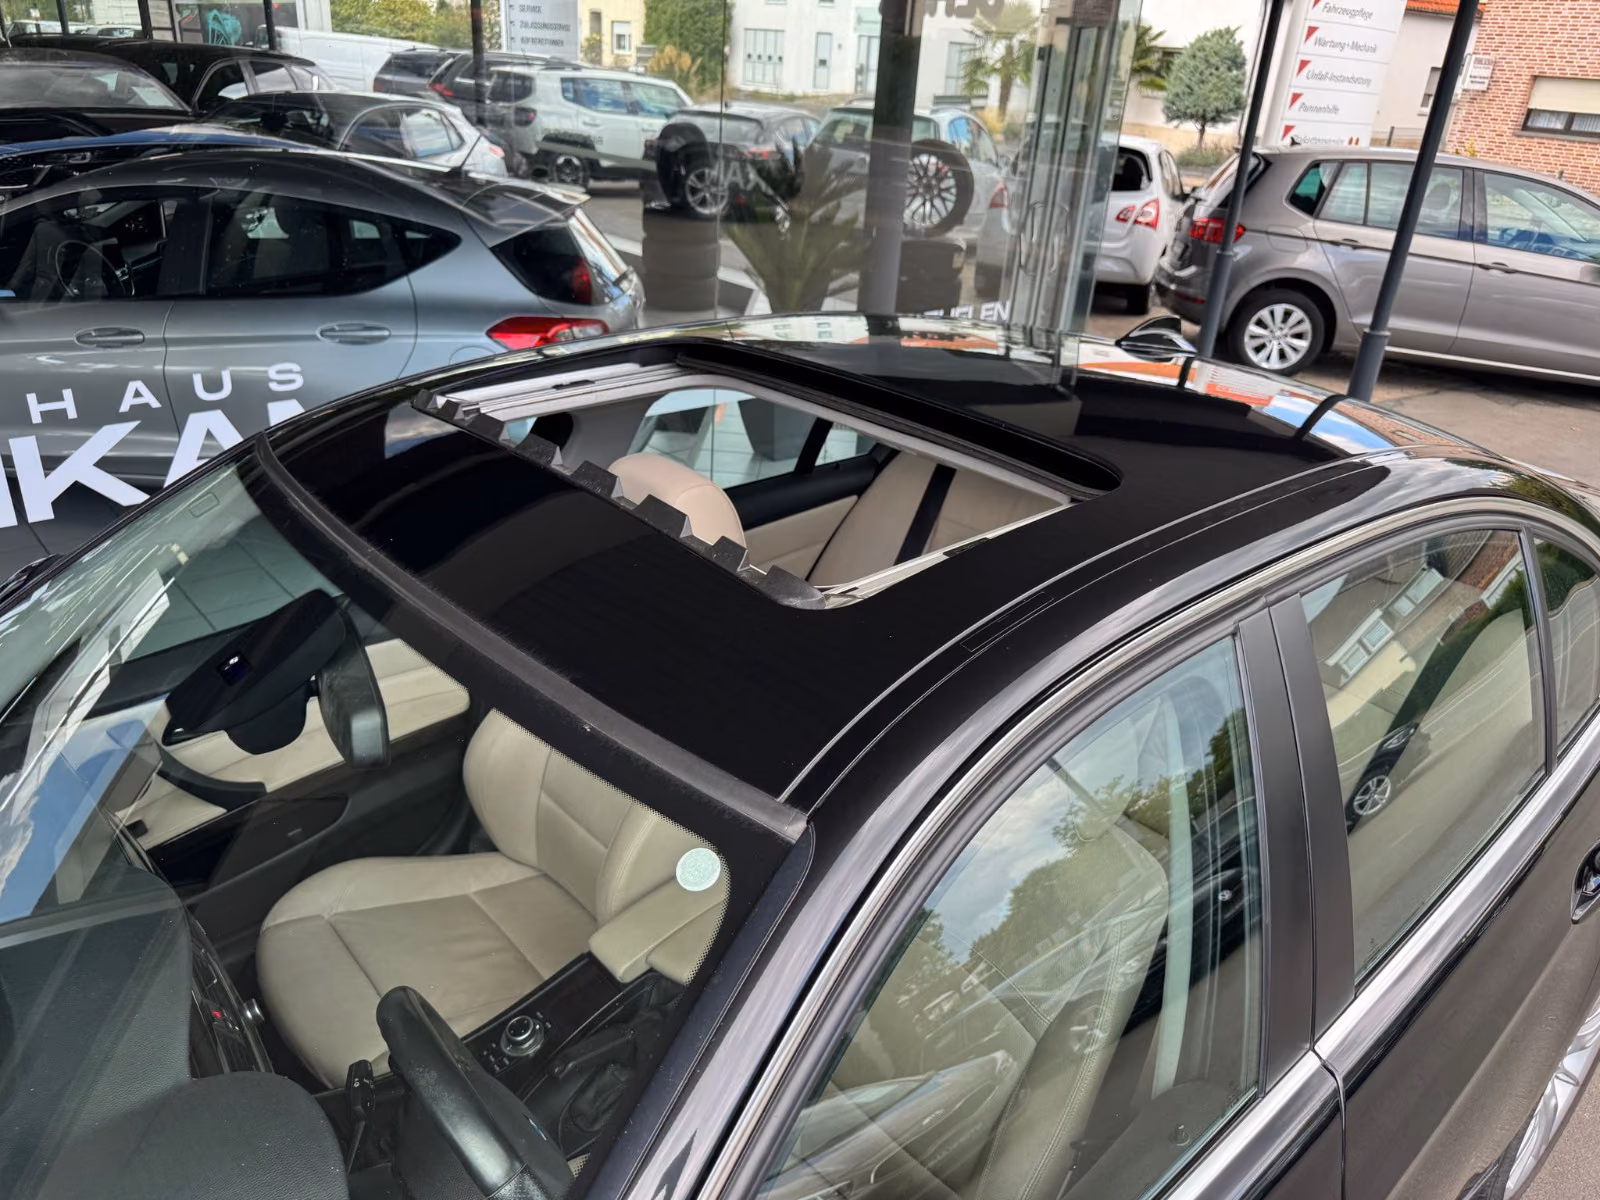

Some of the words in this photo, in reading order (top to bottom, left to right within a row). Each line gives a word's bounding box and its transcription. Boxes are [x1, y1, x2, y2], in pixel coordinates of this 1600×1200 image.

[1322, 2, 1374, 20] Fahrzeugpflege
[1298, 102, 1340, 114] Pannenhilfe
[26, 362, 304, 424] HAUS
